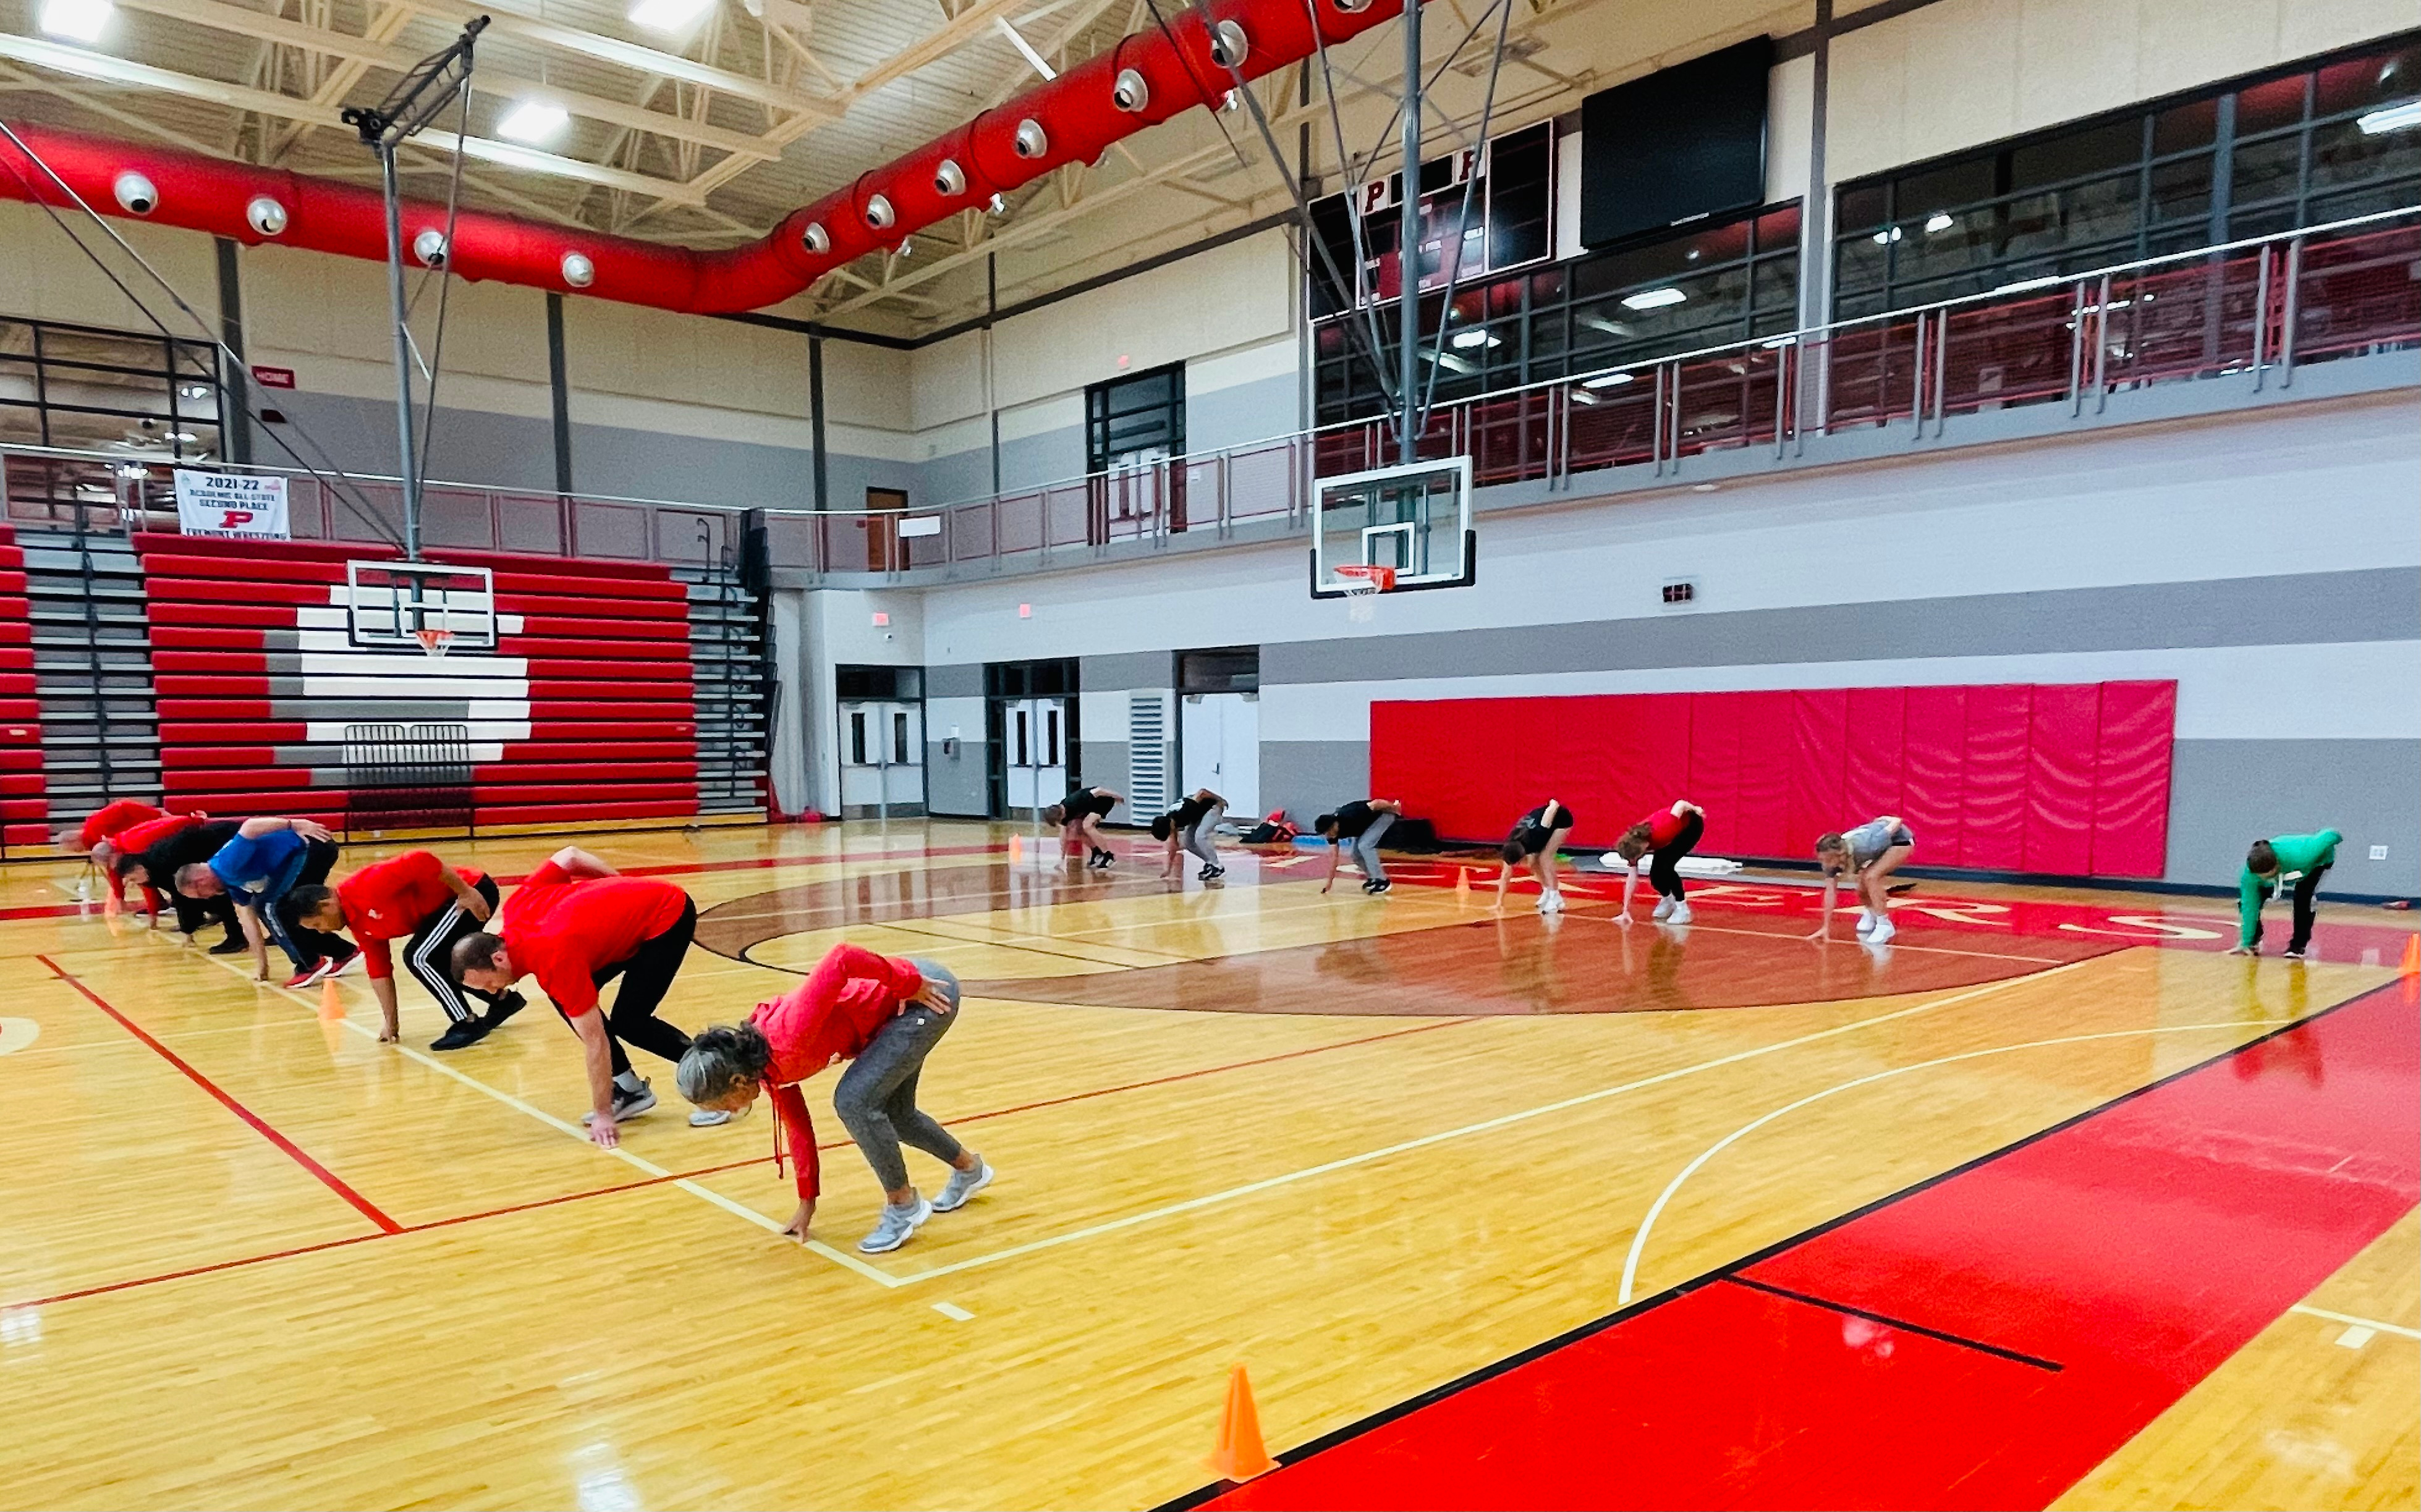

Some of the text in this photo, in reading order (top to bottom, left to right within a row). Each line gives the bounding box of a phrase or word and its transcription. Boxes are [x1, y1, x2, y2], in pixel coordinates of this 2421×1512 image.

[1365, 181, 1384, 213] P
[205, 476, 259, 490] 2021-22
[199, 499, 268, 510] SECOND PLACE
[219, 510, 253, 529] P
